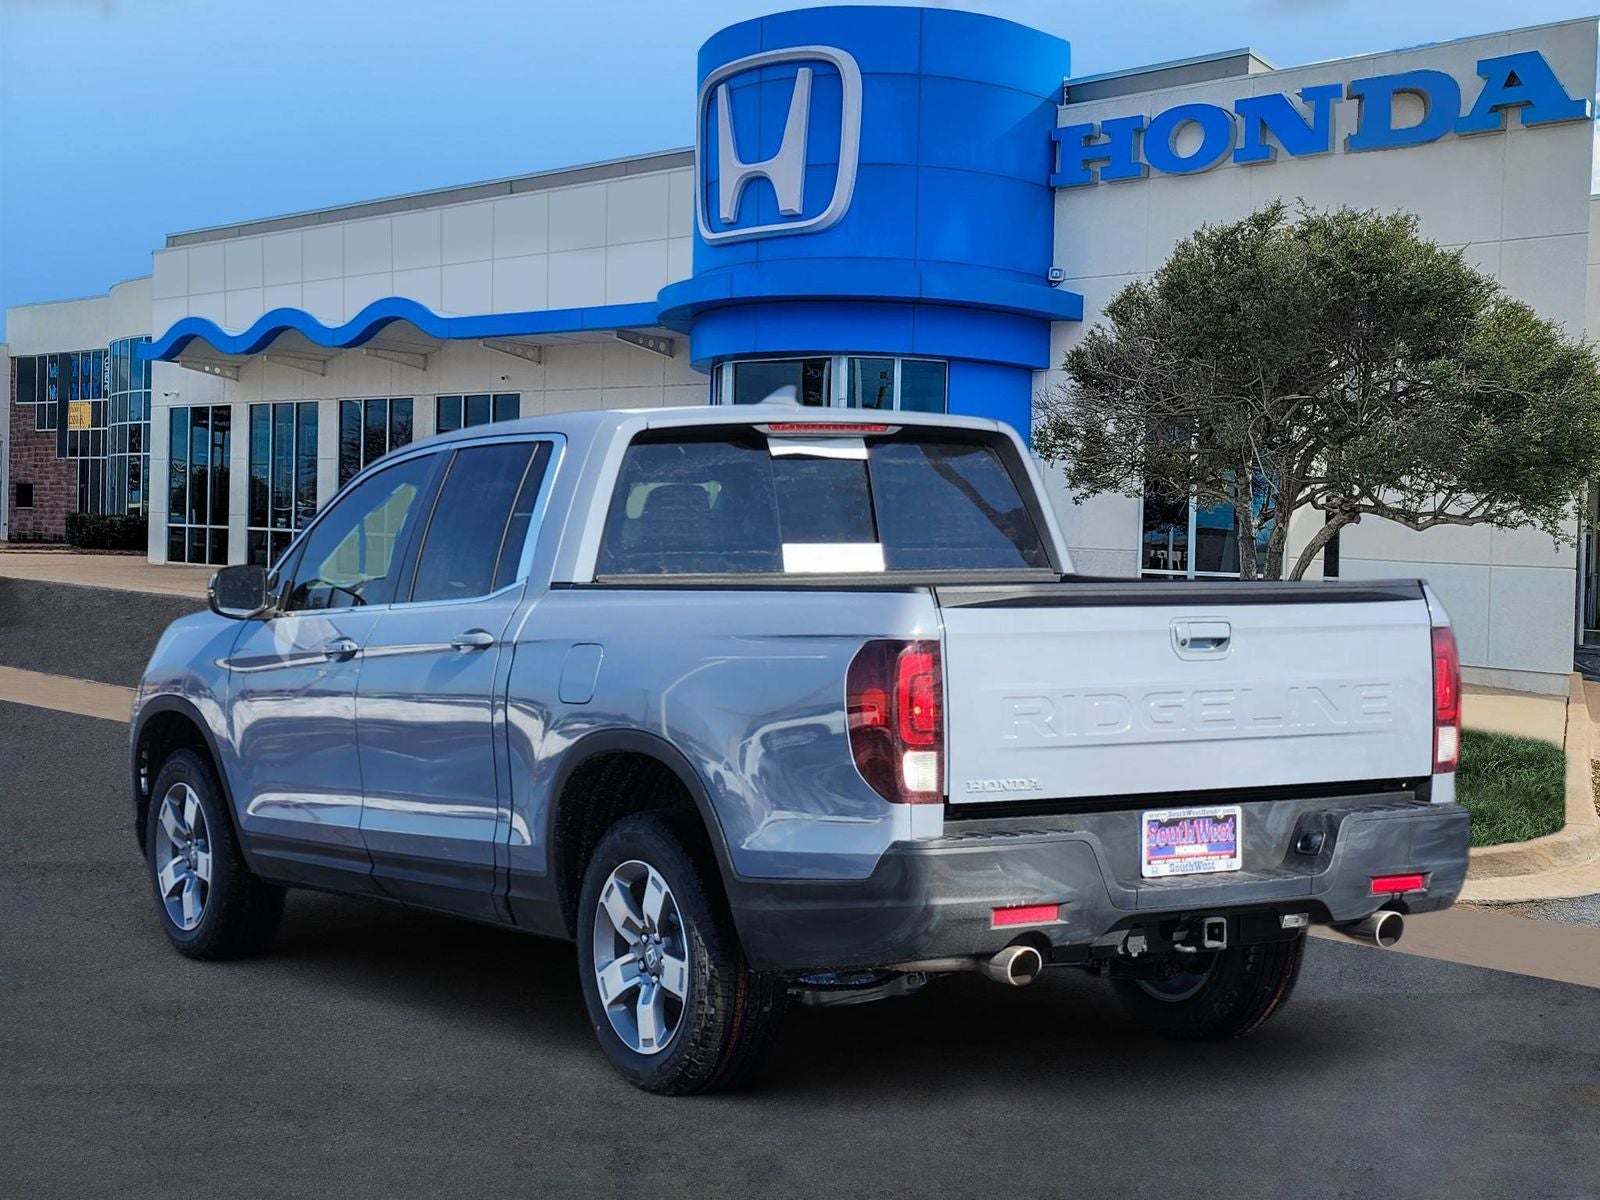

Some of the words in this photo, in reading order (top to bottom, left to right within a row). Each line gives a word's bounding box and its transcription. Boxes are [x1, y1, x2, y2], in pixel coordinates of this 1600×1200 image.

[1050, 50, 1592, 188] HONDA
[1002, 683, 1393, 739] RIDGELINE
[966, 777, 1043, 794] HONDA
[1147, 817, 1235, 847] SouthWest
[1168, 861, 1215, 873] SouthWest
